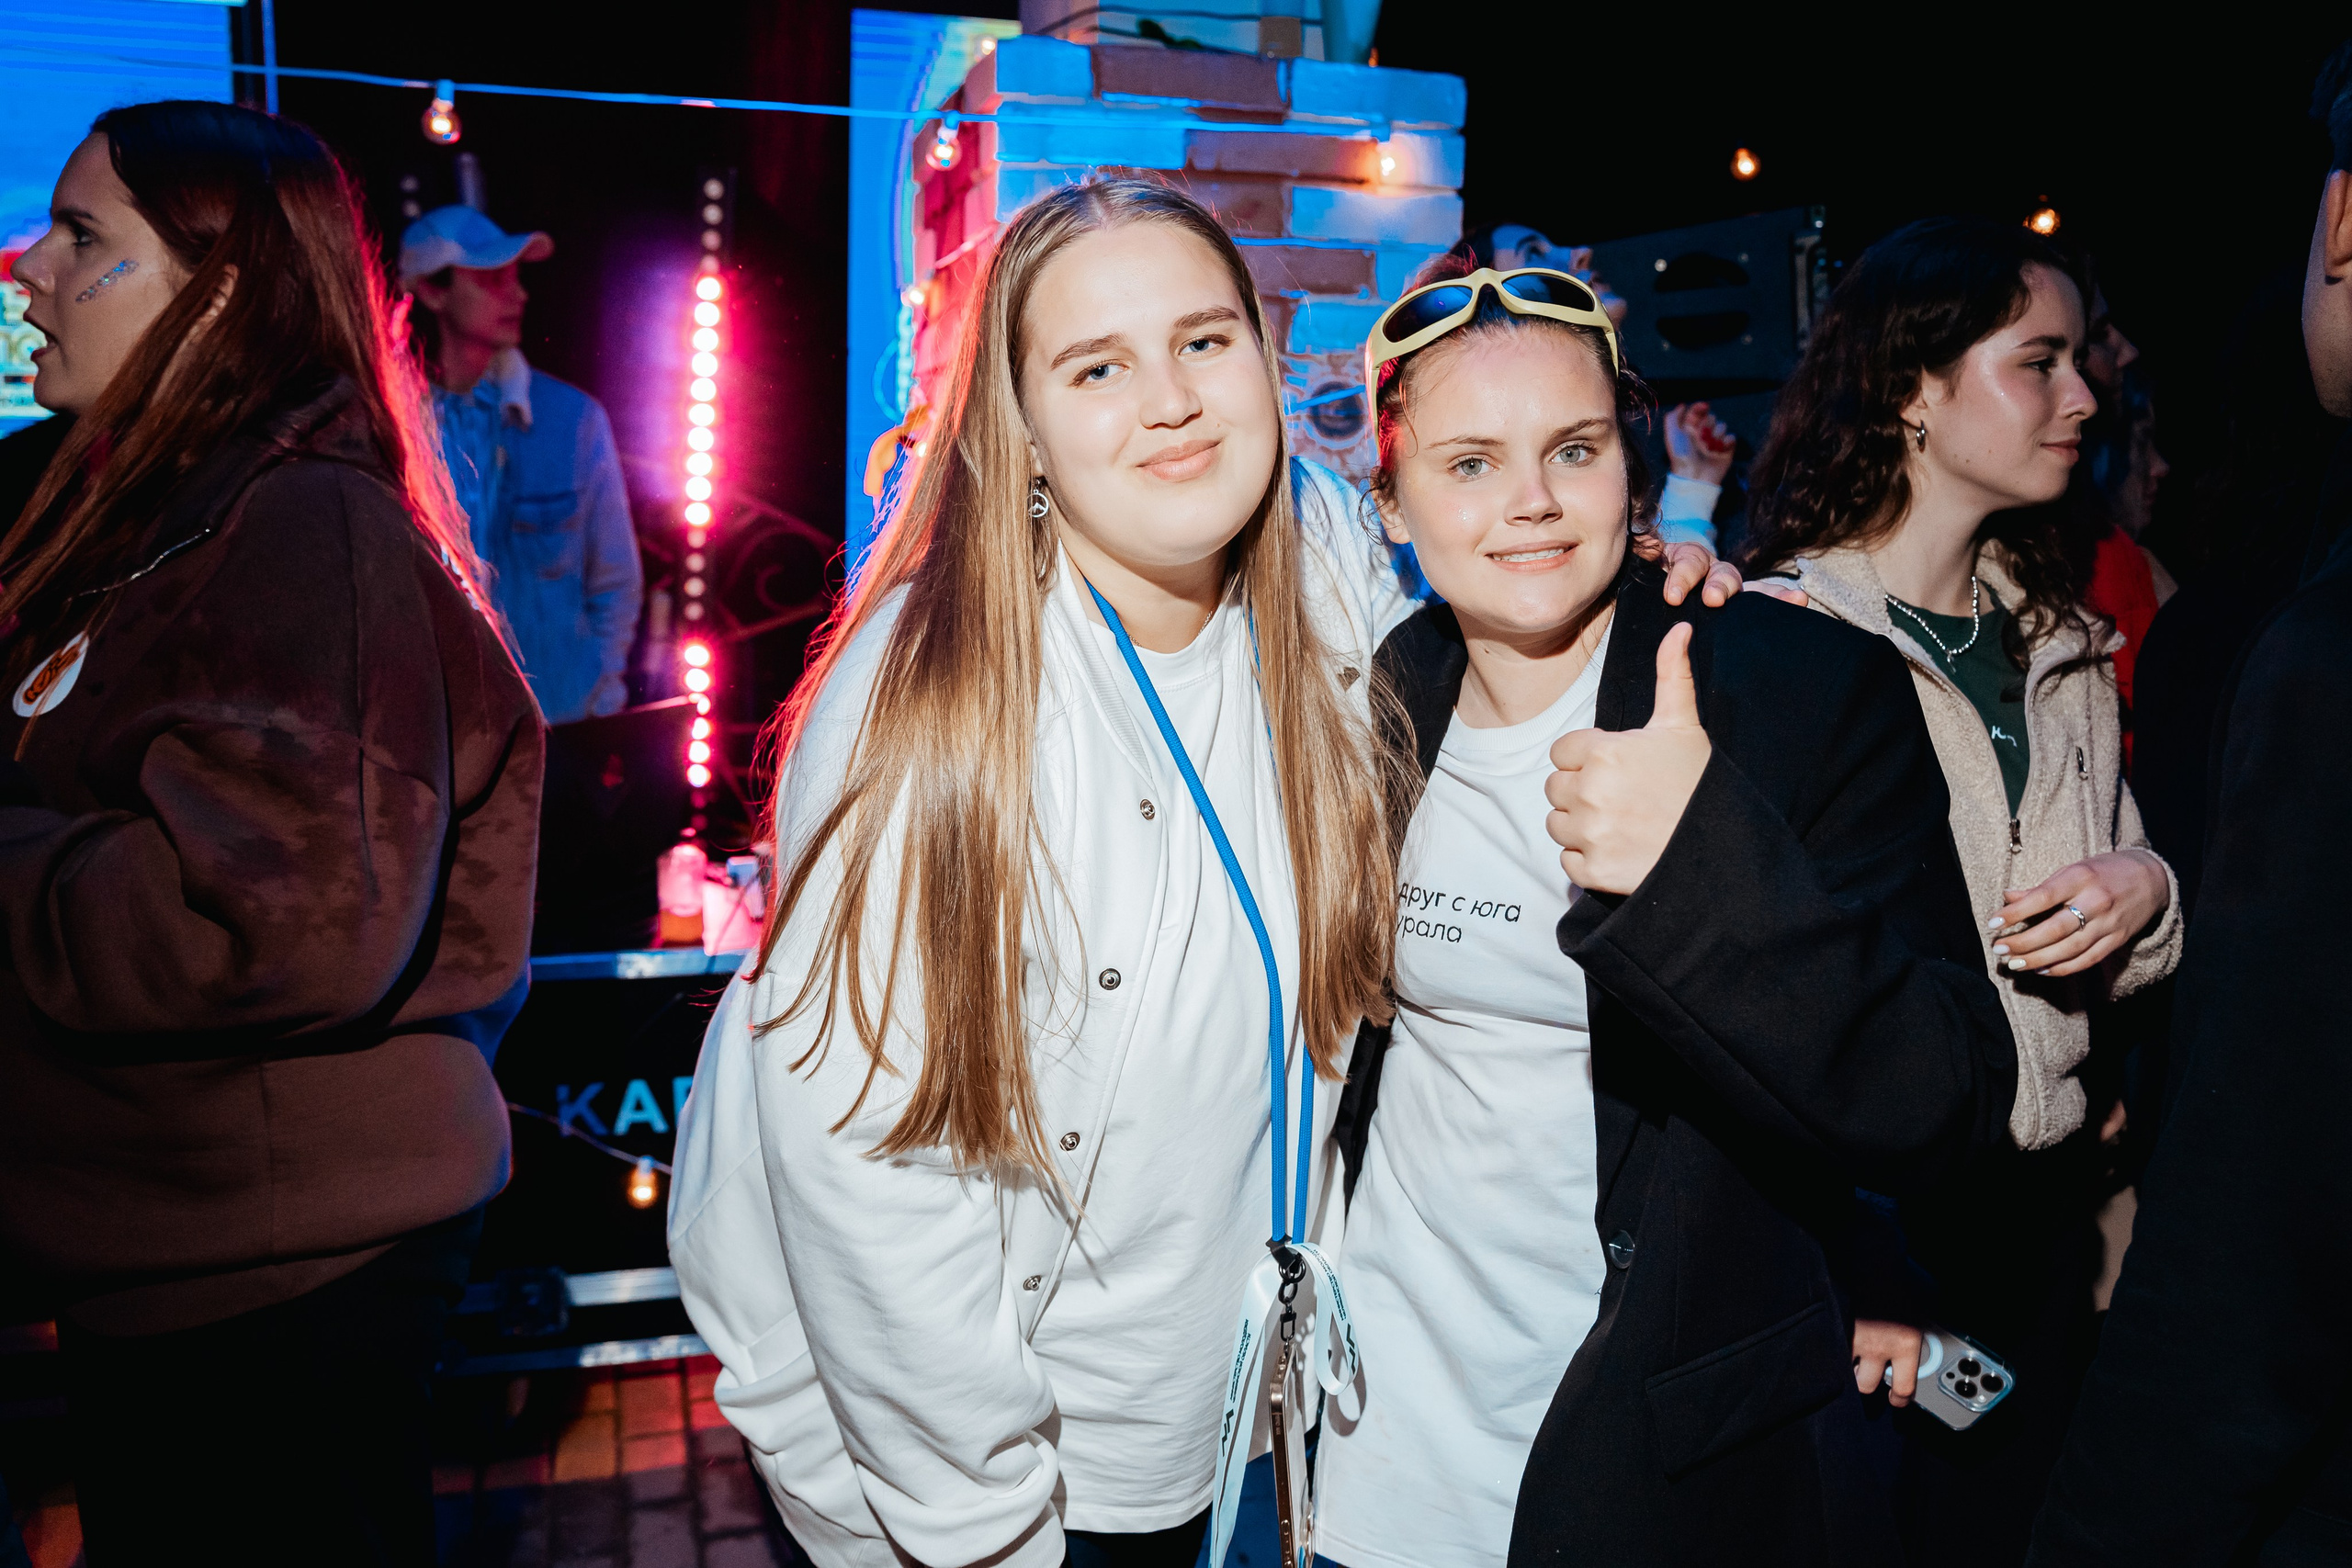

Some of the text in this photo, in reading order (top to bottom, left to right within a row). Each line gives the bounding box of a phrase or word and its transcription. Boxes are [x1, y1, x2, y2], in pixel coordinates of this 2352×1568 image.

[1398, 883, 1521, 922] друг с юга
